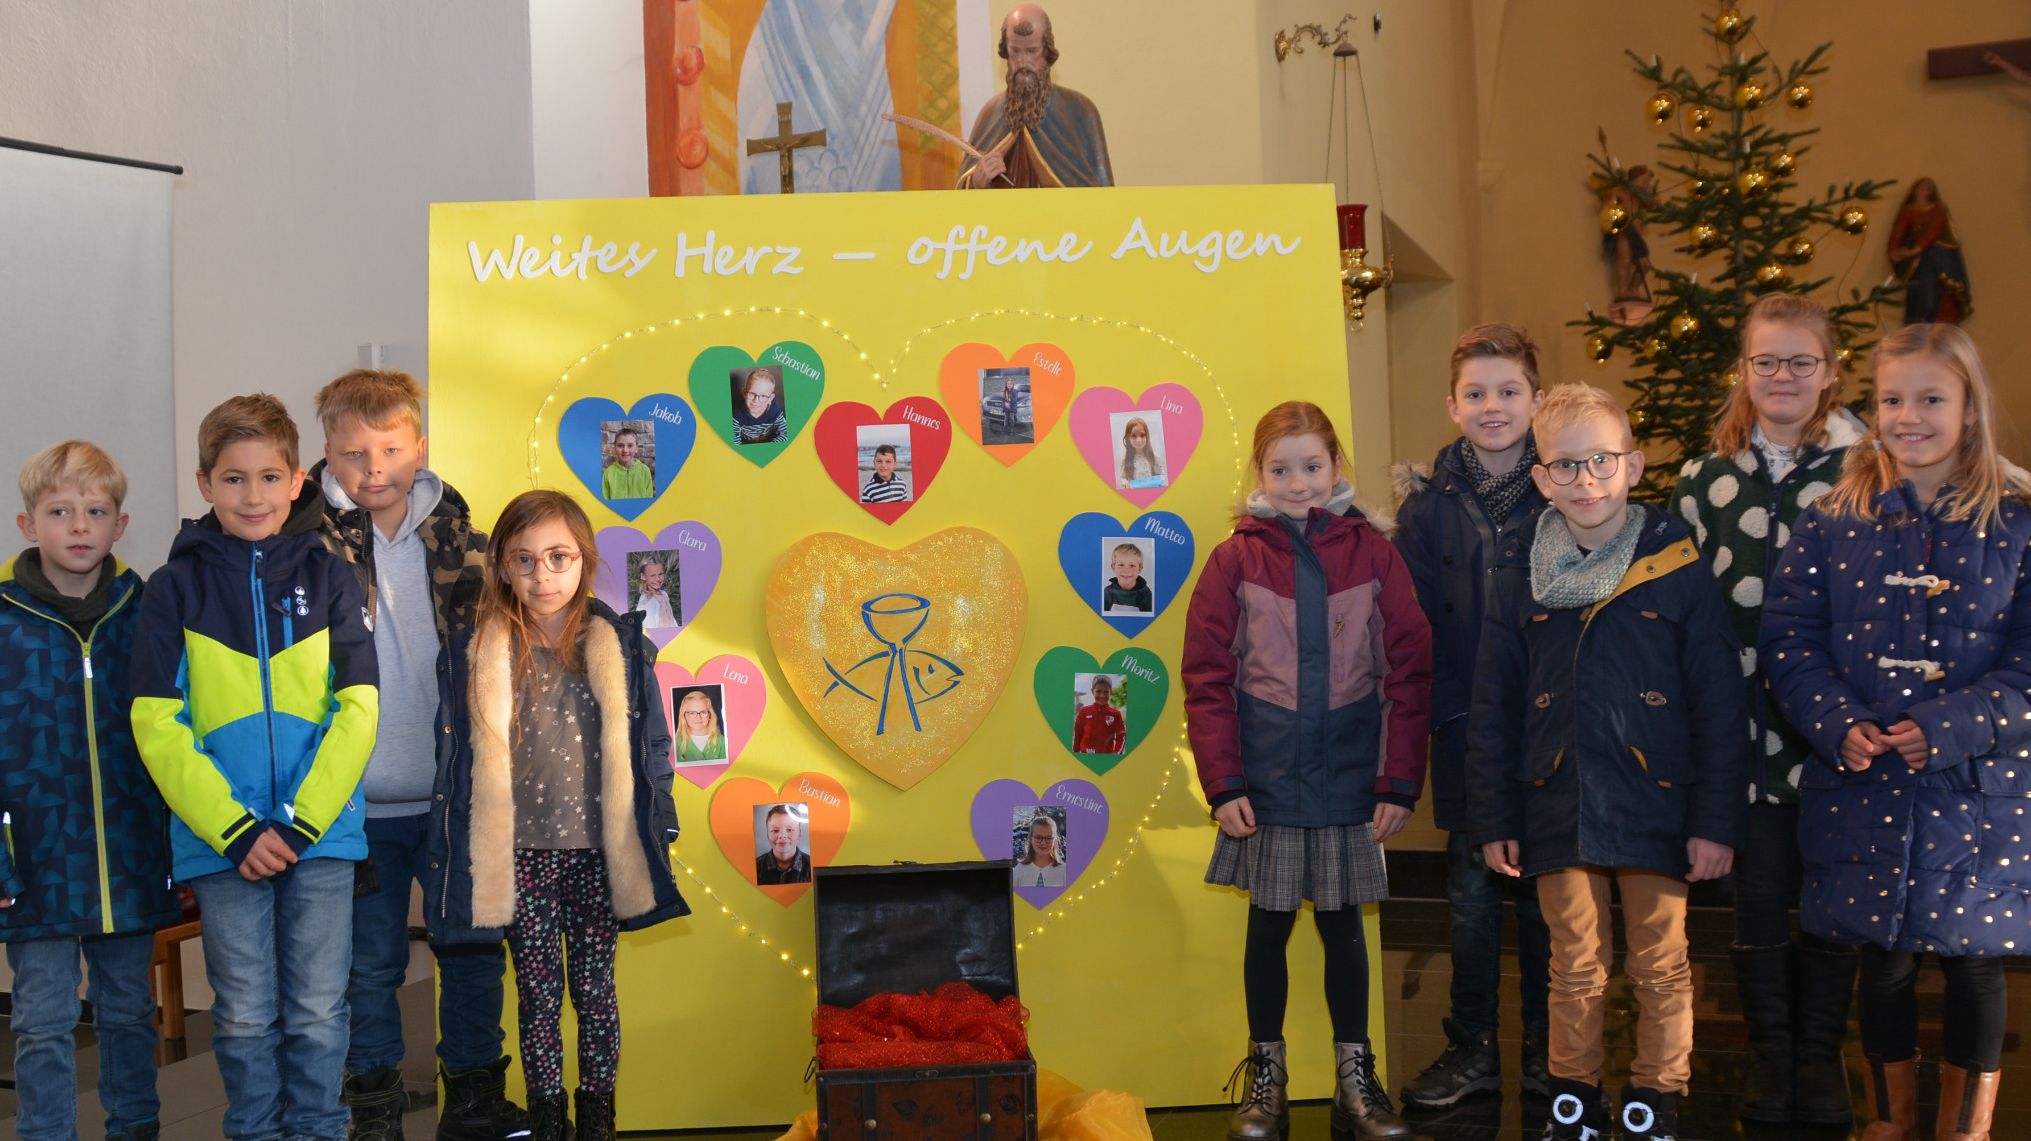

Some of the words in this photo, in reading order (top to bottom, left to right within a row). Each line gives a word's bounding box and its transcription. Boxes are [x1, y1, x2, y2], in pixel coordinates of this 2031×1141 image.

[467, 233, 658, 282] Weites
[675, 230, 804, 278] Herz
[906, 224, 1093, 280] offene
[1111, 216, 1302, 273] Augen
[772, 346, 821, 381] Sebastian
[1033, 352, 1063, 377] Estelle
[649, 403, 682, 425] Jakob
[1160, 394, 1183, 414] Lina
[903, 405, 941, 431] Hannes
[678, 529, 707, 551] Clara
[1144, 516, 1185, 545] Matteo
[723, 663, 749, 685] Lena
[1121, 654, 1160, 684] Moritz
[798, 779, 841, 808] Bastian
[1056, 784, 1103, 814] Ernestine
